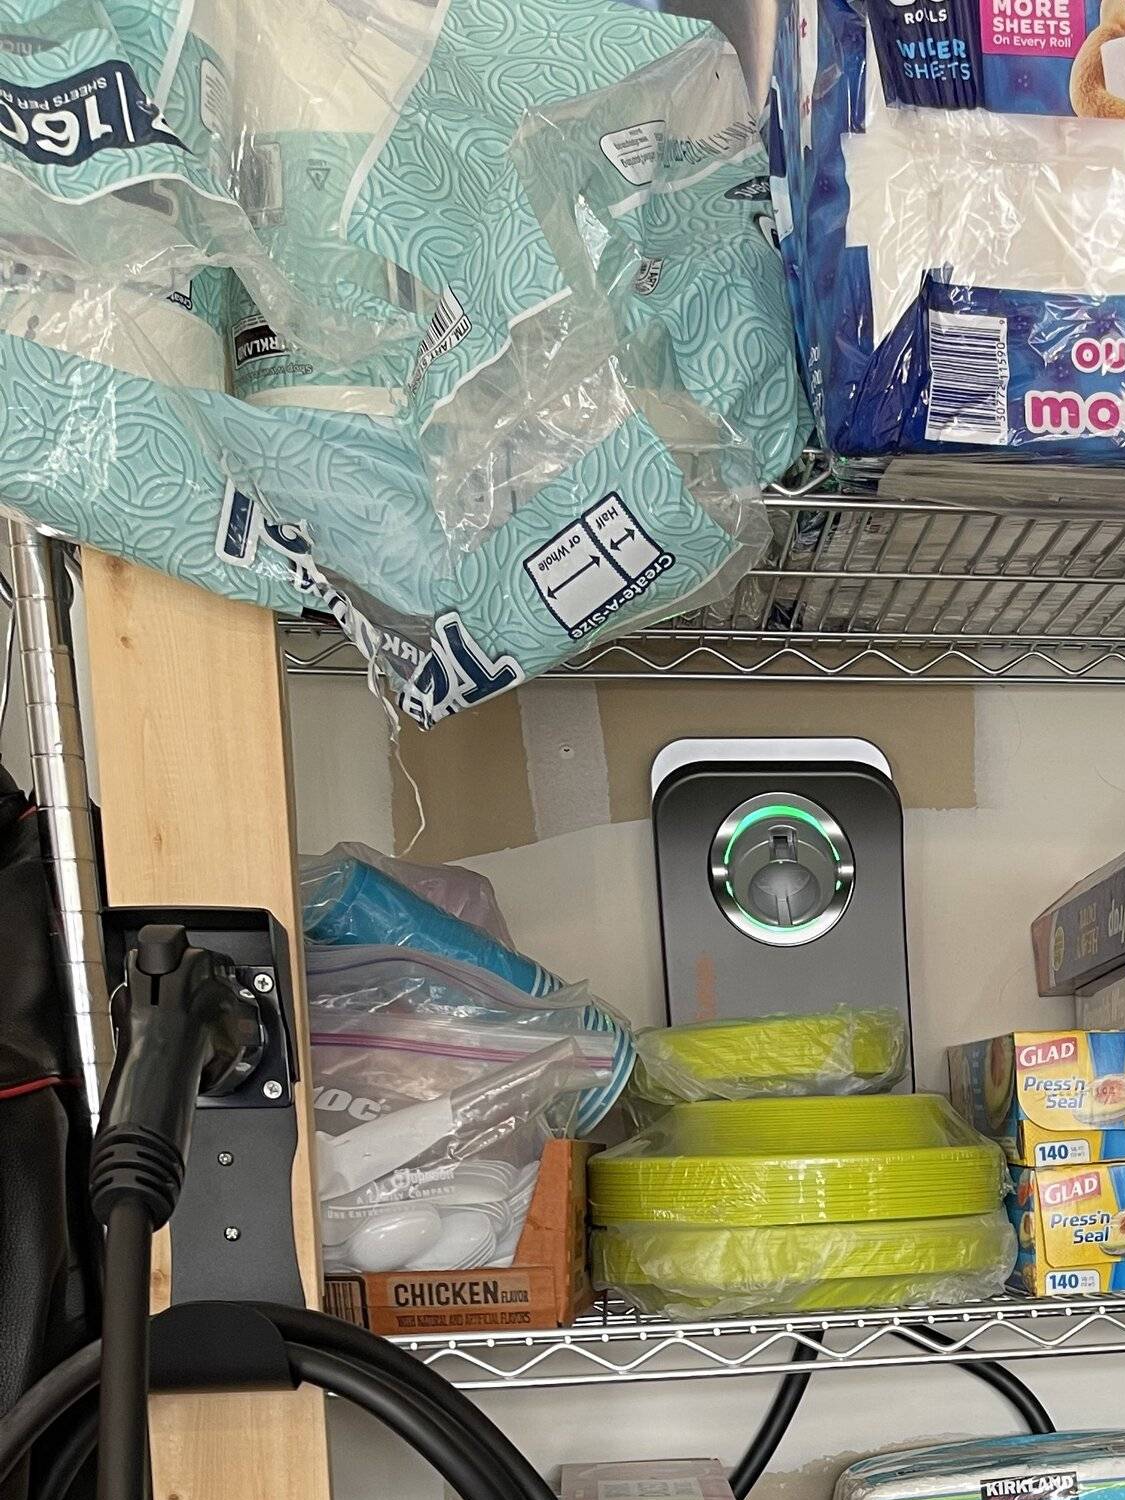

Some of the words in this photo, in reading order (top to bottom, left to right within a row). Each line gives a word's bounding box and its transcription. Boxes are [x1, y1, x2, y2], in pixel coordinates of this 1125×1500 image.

[992, 0, 1070, 17] MORE
[992, 19, 1071, 35] SHEETS
[993, 35, 1010, 46] On
[1012, 35, 1045, 49] Every
[1048, 36, 1071, 48] Roll
[54, 76, 107, 108] SHEETS
[596, 506, 618, 530] Half
[537, 544, 569, 572] Whole
[572, 552, 675, 640] Create-A-Size
[1018, 1041, 1076, 1069] GLAD
[1023, 1076, 1085, 1093] Press'n
[1045, 1092, 1084, 1110] Seal
[1038, 1145, 1069, 1163] 140
[1043, 1177, 1098, 1206] GLAD
[1050, 1210, 1110, 1229] Press'n
[1073, 1225, 1111, 1244] Seal
[1049, 1274, 1079, 1291] 140
[394, 1280, 499, 1307] CHICKEN
[986, 1475, 1073, 1498] KIRKLAND
